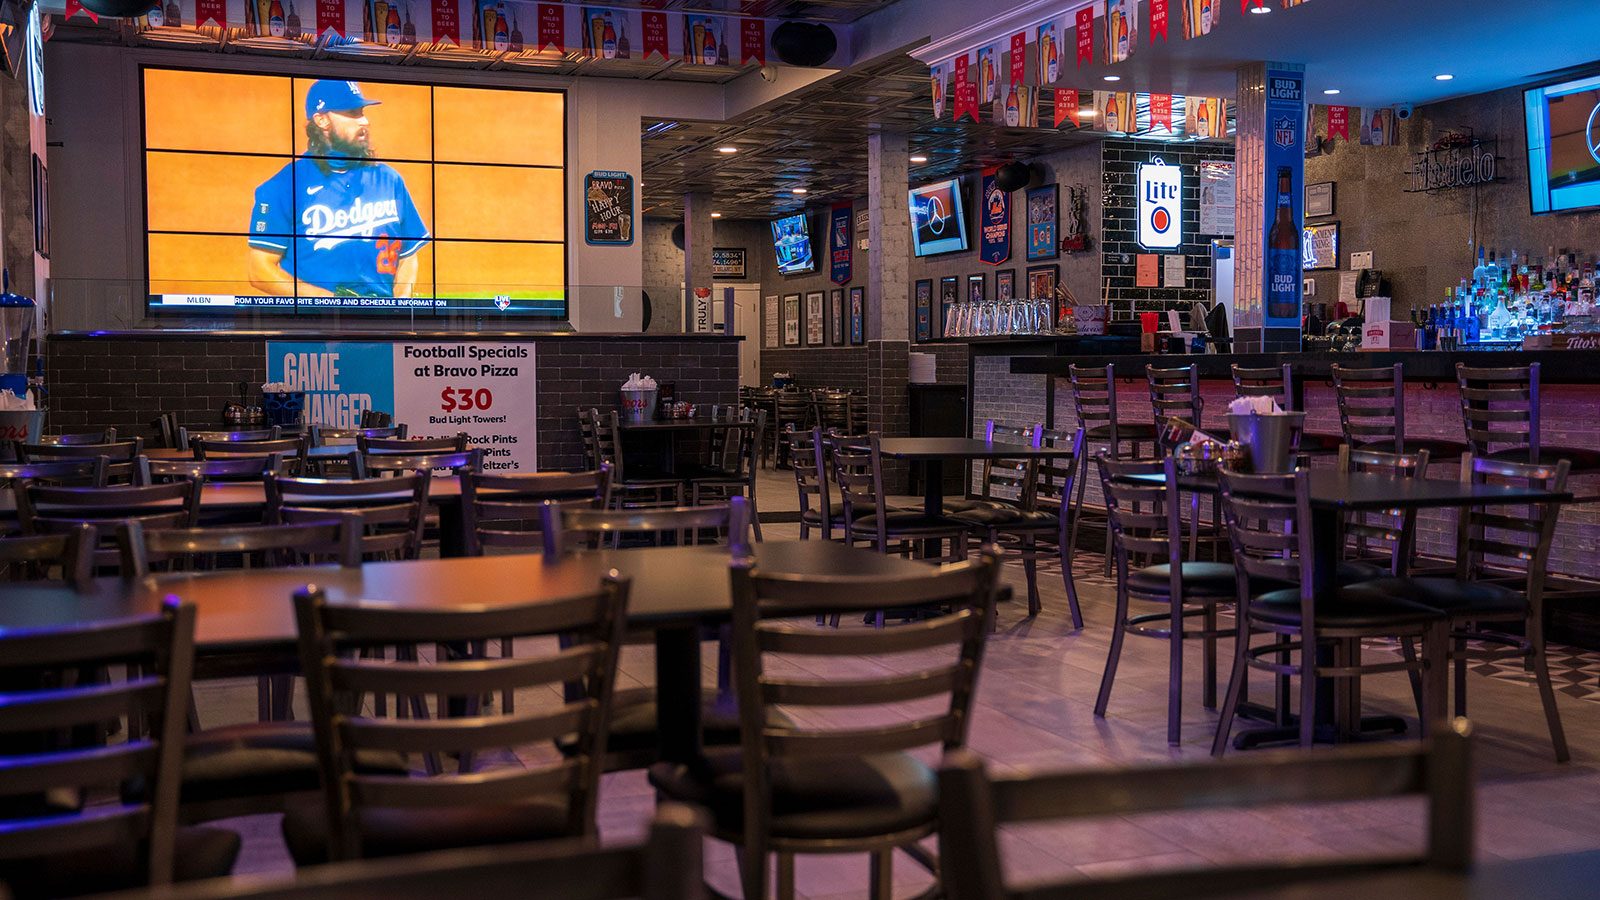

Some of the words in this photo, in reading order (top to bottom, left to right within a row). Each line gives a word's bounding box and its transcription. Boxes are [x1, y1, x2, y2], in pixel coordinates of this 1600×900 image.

[1153, 11, 1165, 21] BEER
[1079, 38, 1091, 48] BEER
[1274, 80, 1296, 90] BUD
[1270, 88, 1300, 99] LIGHT
[1275, 130, 1294, 145] NFL
[592, 180, 613, 190] BRAVO
[1145, 180, 1178, 204] Lite
[592, 193, 620, 213] HAPPY
[302, 197, 398, 242] Dodgers
[600, 205, 623, 222] HOUR
[1274, 275, 1293, 283] BUD
[1271, 283, 1296, 292] LIGHT
[186, 296, 212, 304] MLBN
[314, 298, 342, 306] SHOWS
[342, 298, 359, 306] AND
[397, 299, 447, 307] INFORMATION
[698, 299, 707, 332] TRULY
[1566, 336, 1597, 350] Tito's
[404, 345, 465, 359] Football
[468, 345, 528, 361] Specials
[284, 353, 340, 392] GAME
[414, 365, 430, 377] at
[434, 364, 477, 377] Bravo
[481, 364, 519, 377] Pizza
[440, 386, 493, 413] $30
[302, 393, 373, 430] HANGER
[429, 416, 447, 424] Bud
[449, 416, 471, 425] Light
[472, 415, 507, 424] Towers!
[0, 423, 30, 440] ors
[466, 435, 490, 444] Rock
[492, 435, 518, 444] Pints
[486, 448, 511, 457] Pints
[483, 461, 520, 470] eltzer's
